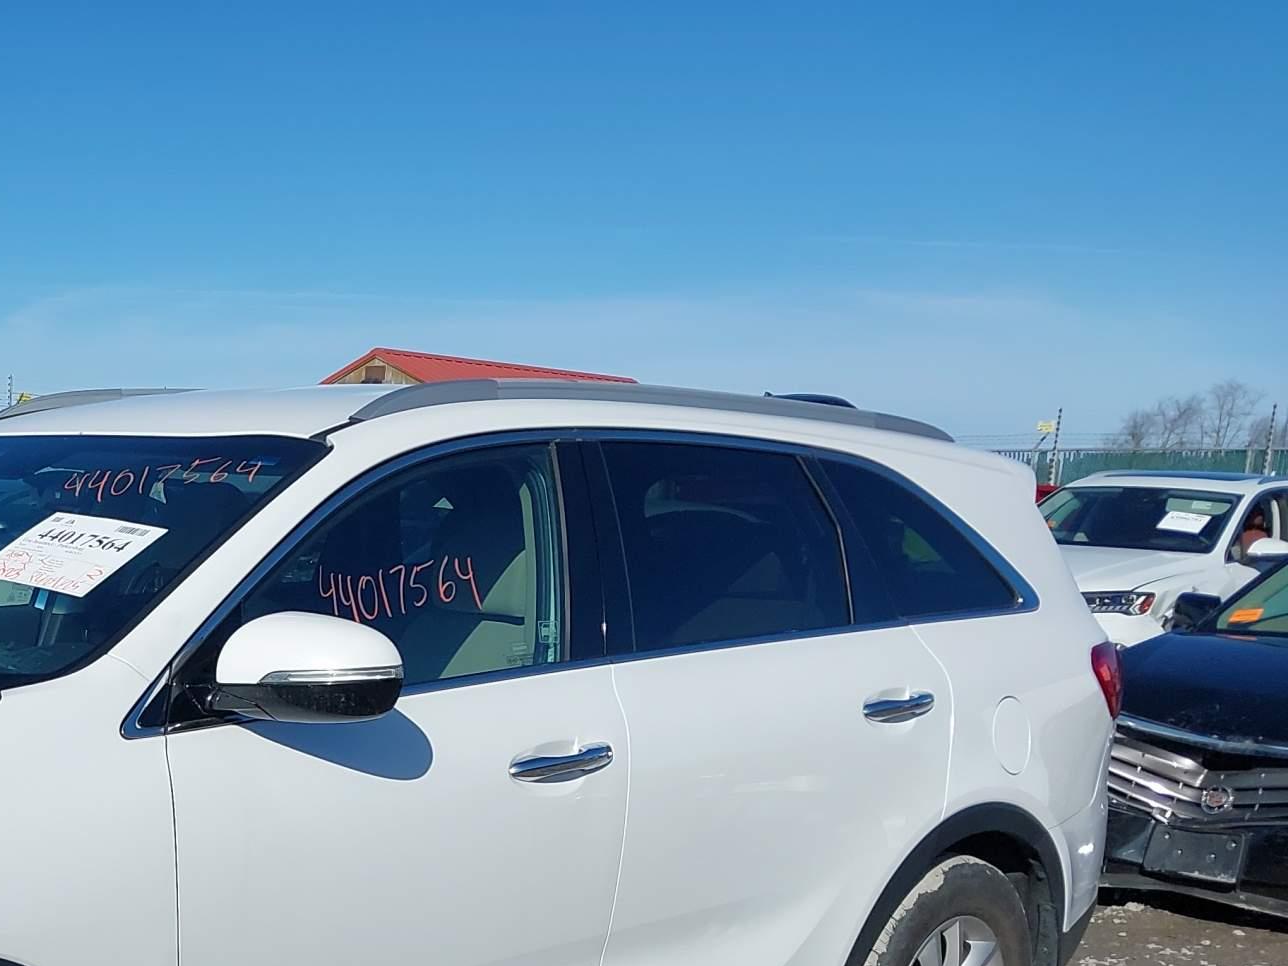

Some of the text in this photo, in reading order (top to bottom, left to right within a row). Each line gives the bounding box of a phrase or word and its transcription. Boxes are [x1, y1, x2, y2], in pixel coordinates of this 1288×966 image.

[64, 456, 263, 504] 44017564
[37, 528, 132, 553] 44017564
[319, 554, 483, 623] 44017564
